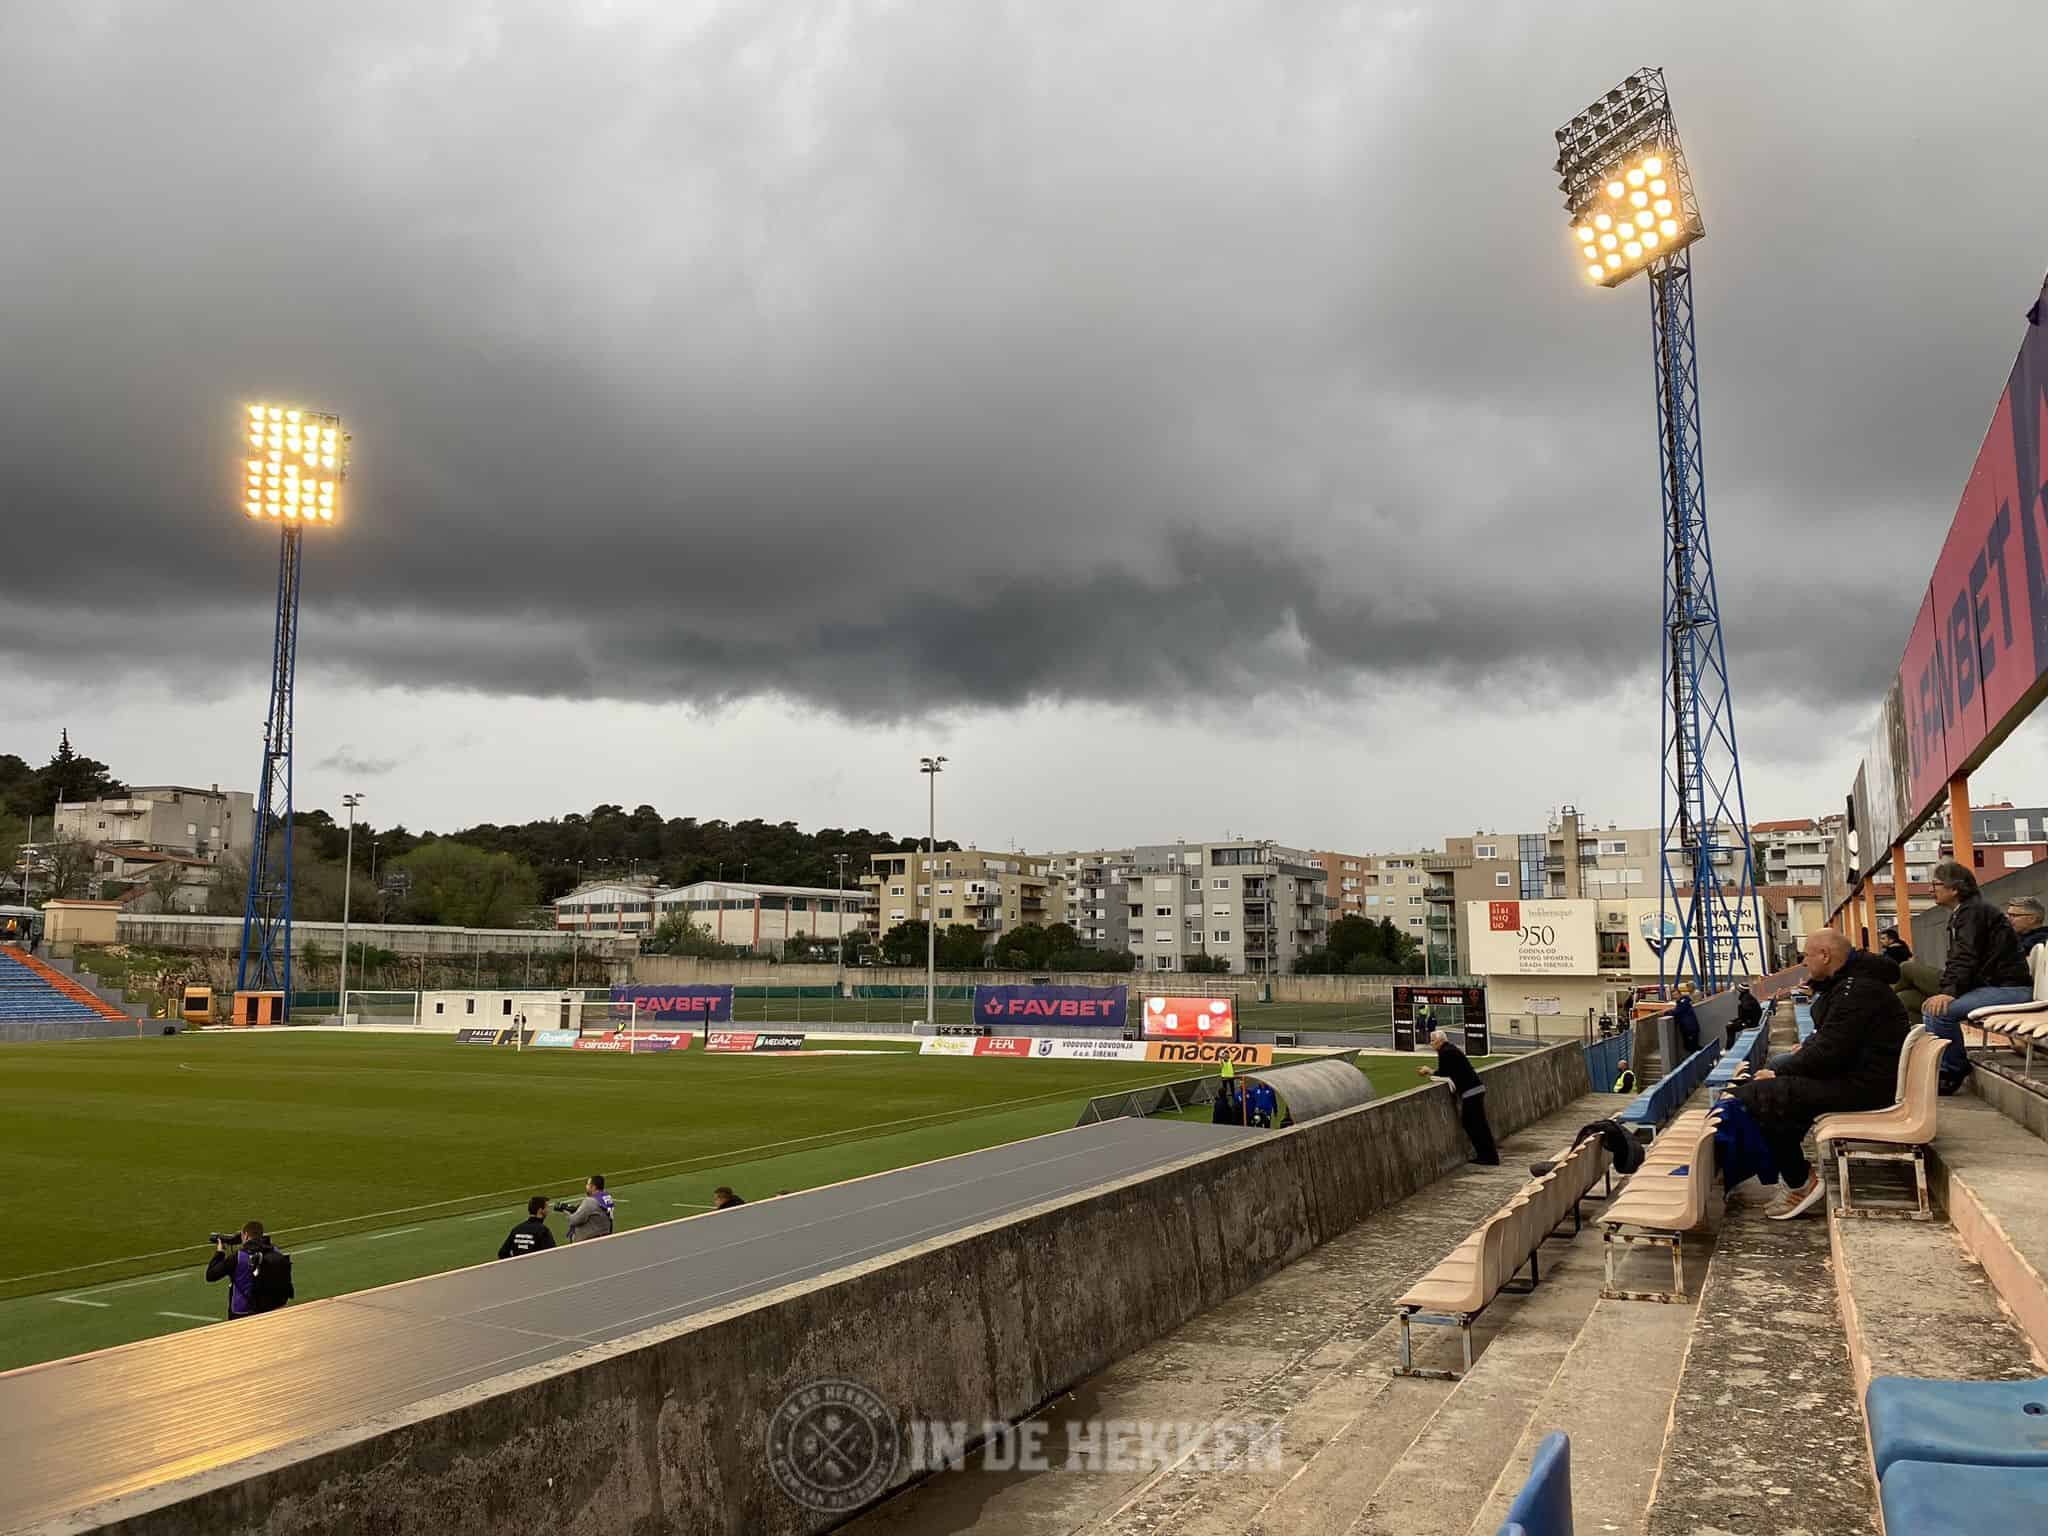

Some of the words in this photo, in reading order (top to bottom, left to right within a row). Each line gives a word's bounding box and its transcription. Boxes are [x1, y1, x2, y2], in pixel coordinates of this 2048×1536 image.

[1516, 925, 1555, 946] 950
[635, 996, 721, 1012] FAVBET
[1008, 999, 1115, 1017] FAVBET
[583, 1039, 622, 1050] aircash
[988, 1038, 1017, 1050] FEAL
[1159, 1042, 1258, 1063] macron
